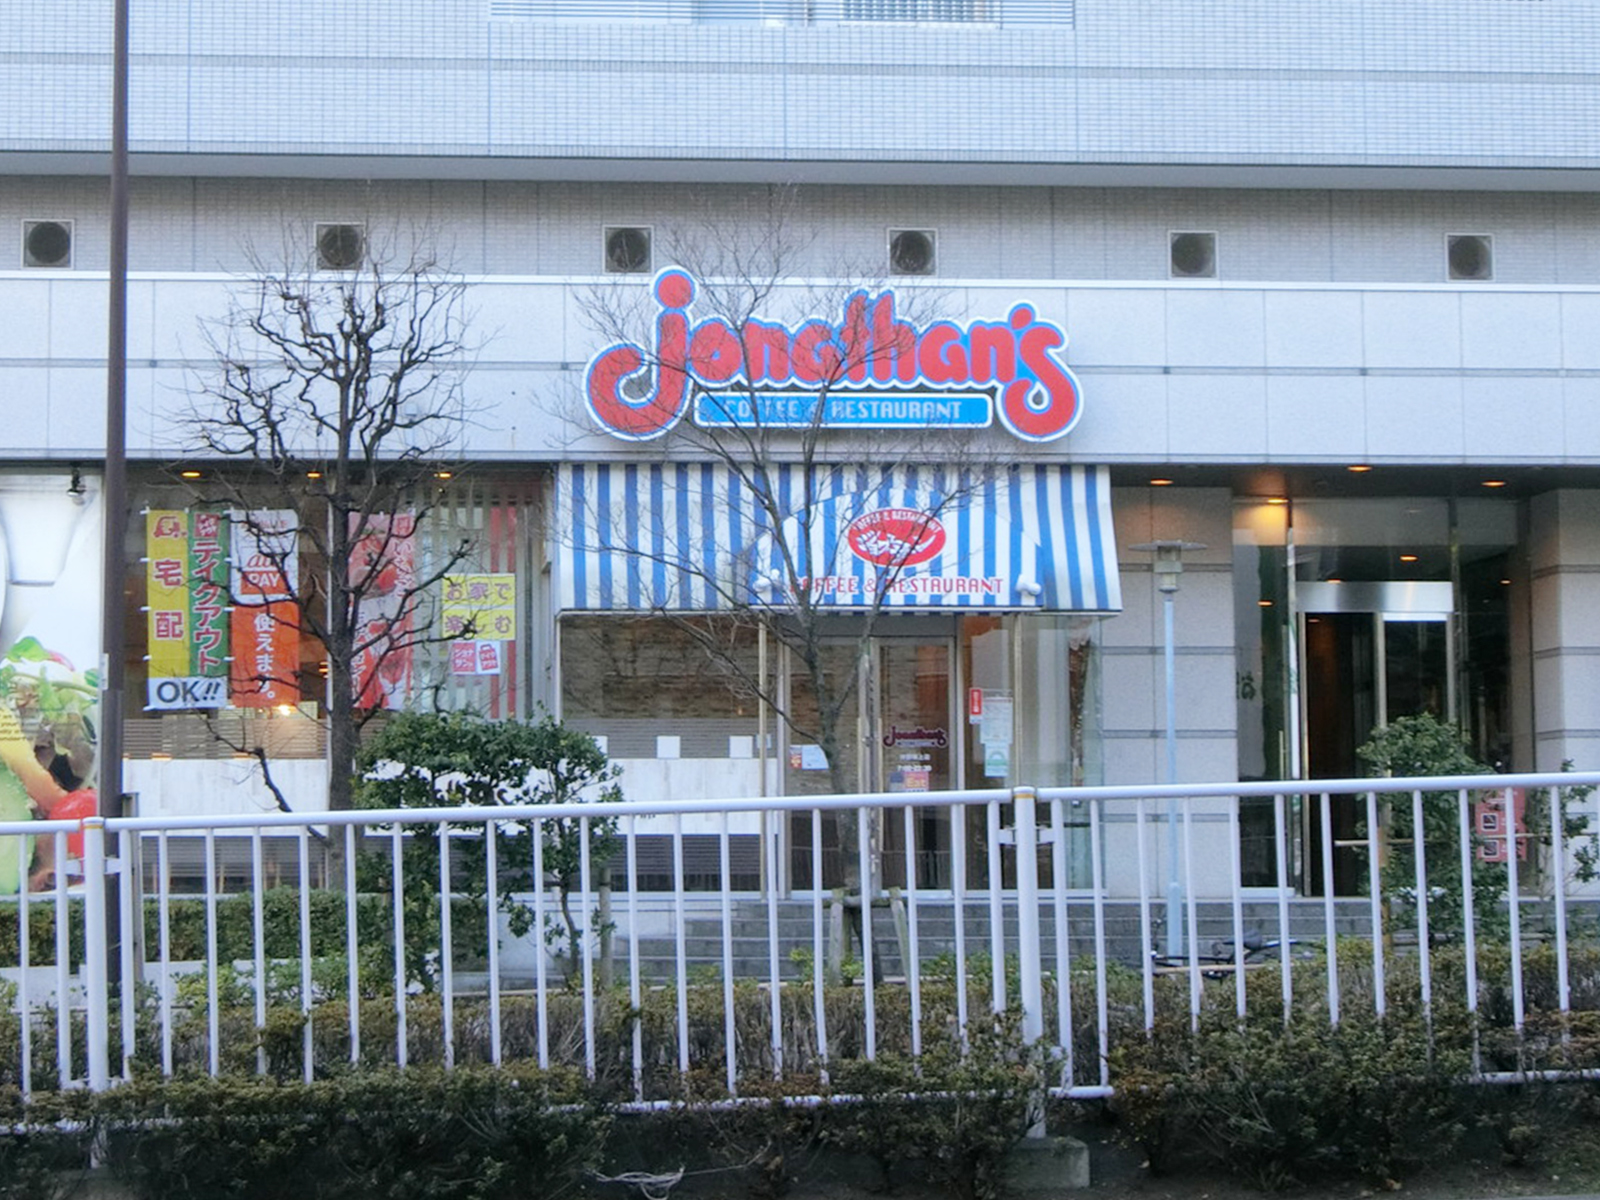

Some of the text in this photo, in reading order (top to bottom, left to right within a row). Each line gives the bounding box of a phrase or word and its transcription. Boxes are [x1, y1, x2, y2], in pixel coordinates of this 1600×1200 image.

[724, 400, 798, 419] COFEE
[832, 400, 962, 420] RESTAURANT
[248, 573, 280, 588] PAY
[790, 577, 856, 594] OFFEE
[154, 559, 184, 639] 宅配
[446, 582, 512, 601] お家で
[192, 542, 221, 675] テイクアウト
[156, 681, 220, 703] OK!!
